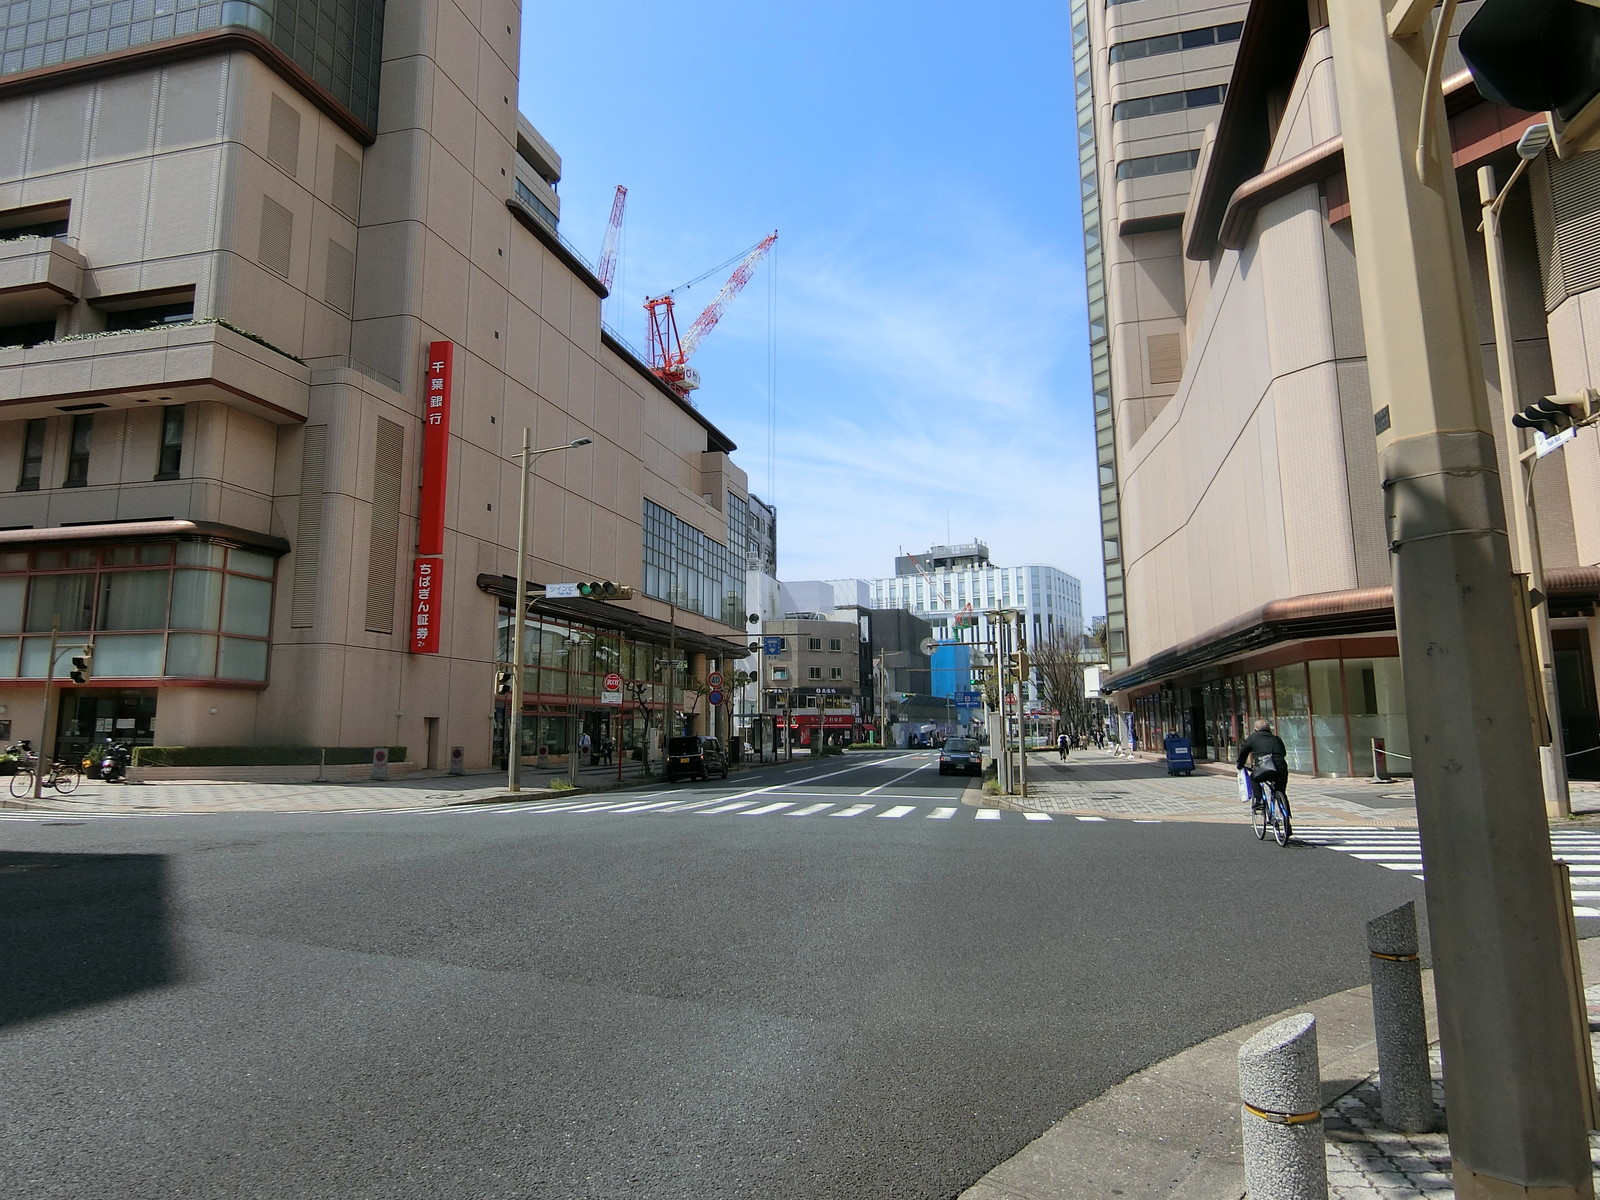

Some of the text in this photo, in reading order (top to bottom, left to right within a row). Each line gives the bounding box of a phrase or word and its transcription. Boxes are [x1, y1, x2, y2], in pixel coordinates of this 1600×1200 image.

[429, 361, 445, 425] 千葉銀行
[416, 564, 432, 639] ちばぎん証券
[711, 676, 720, 684] 40
